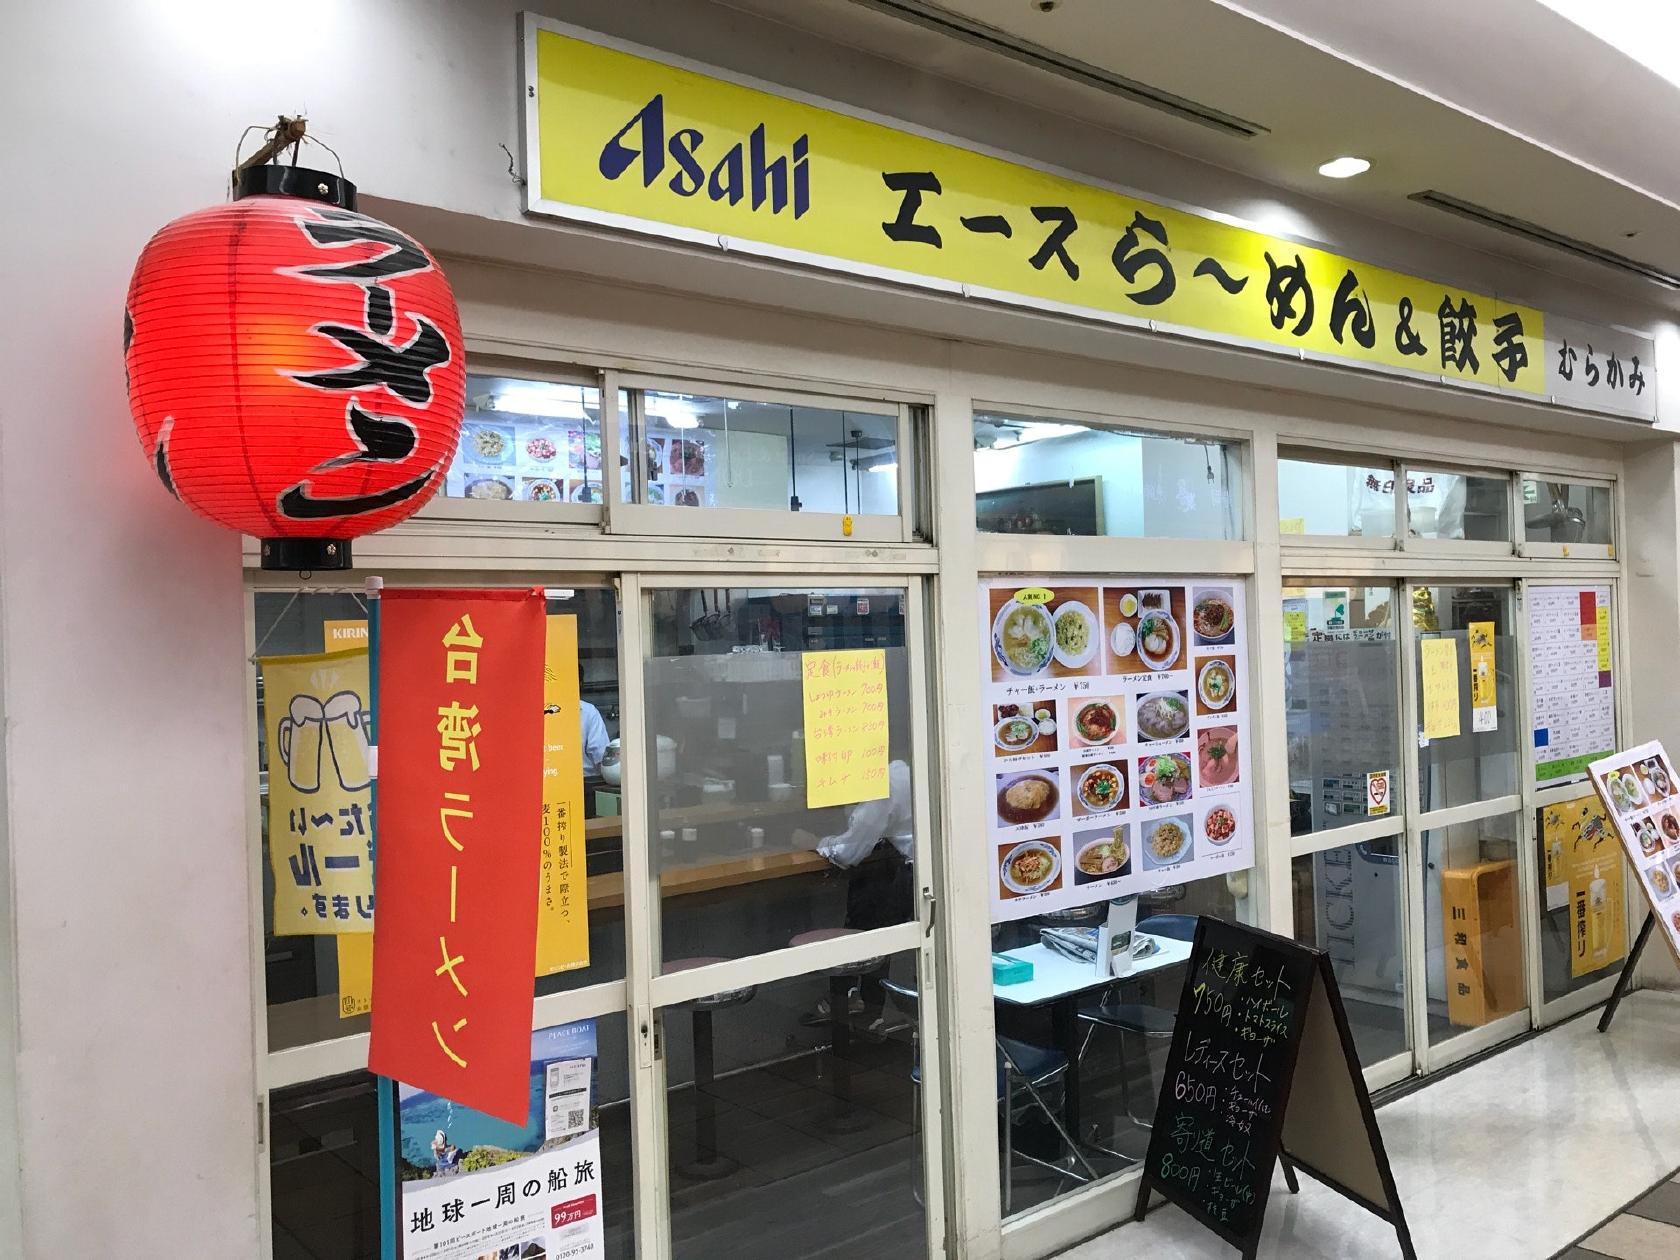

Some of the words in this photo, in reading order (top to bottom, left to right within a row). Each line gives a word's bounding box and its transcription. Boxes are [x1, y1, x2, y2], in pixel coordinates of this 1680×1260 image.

[598, 94, 810, 220] Asahi
[1558, 338, 1646, 396] むらかみ
[333, 627, 369, 640] KIRIN
[1202, 948, 1291, 1000] 健康セット
[1193, 982, 1232, 1027] 750円
[1175, 1071, 1217, 1111] 650円
[1161, 1153, 1200, 1192] 800円
[410, 1159, 596, 1234] 地球一周の船旅
[554, 1209, 581, 1225] 99万円
